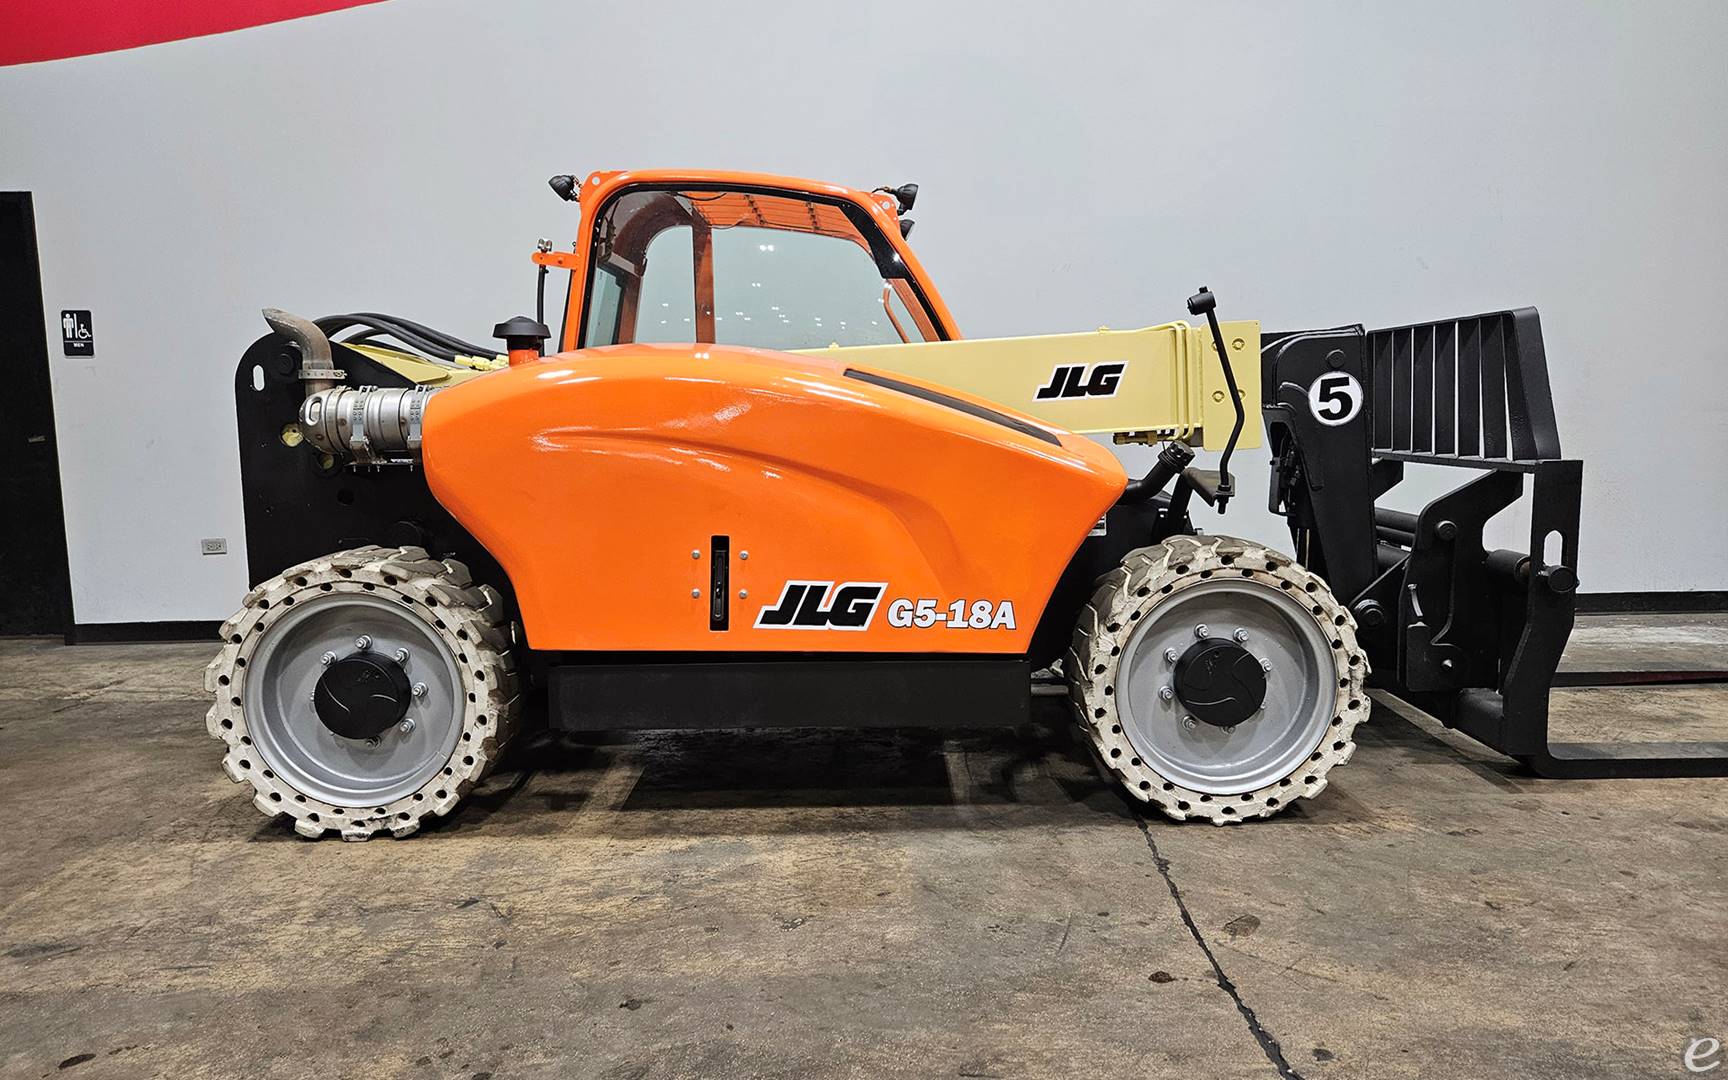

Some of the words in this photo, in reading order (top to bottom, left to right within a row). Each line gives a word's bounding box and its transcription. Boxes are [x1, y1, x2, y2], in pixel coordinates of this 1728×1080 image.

[1035, 363, 1126, 400] JLG
[1317, 376, 1354, 421] 5
[757, 583, 884, 629] JLG
[887, 598, 1017, 630] G5-18A
